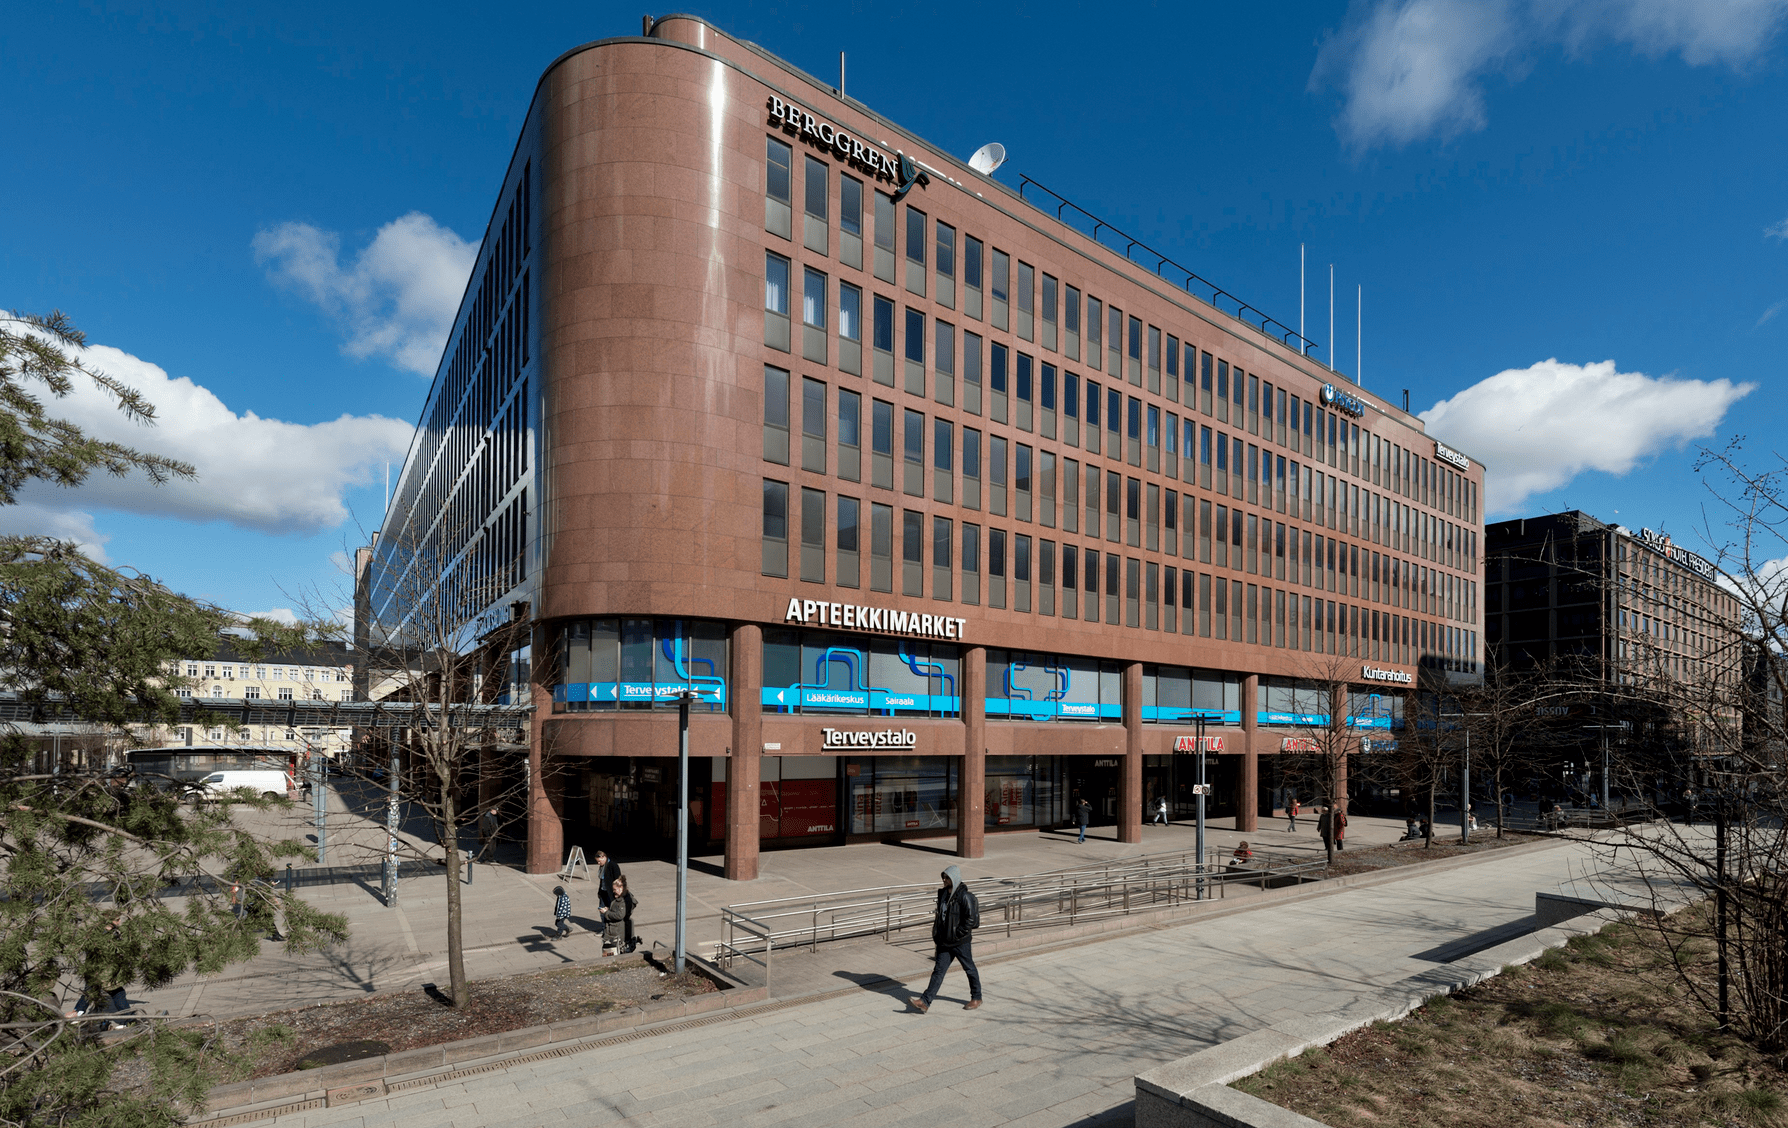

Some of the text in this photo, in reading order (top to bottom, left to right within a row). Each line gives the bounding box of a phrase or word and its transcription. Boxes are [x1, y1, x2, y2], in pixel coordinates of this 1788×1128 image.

[769, 95, 898, 179] BERGGREN
[1436, 441, 1469, 470] Terveystalo
[785, 597, 966, 638] APTEEKKIMARKET
[1363, 665, 1412, 683] Kuntarahoitus
[806, 693, 864, 704] Lääkärikeskus
[885, 696, 915, 706] Sairaala
[823, 728, 917, 749] Terveystalo
[807, 825, 835, 833] ANTTILA
